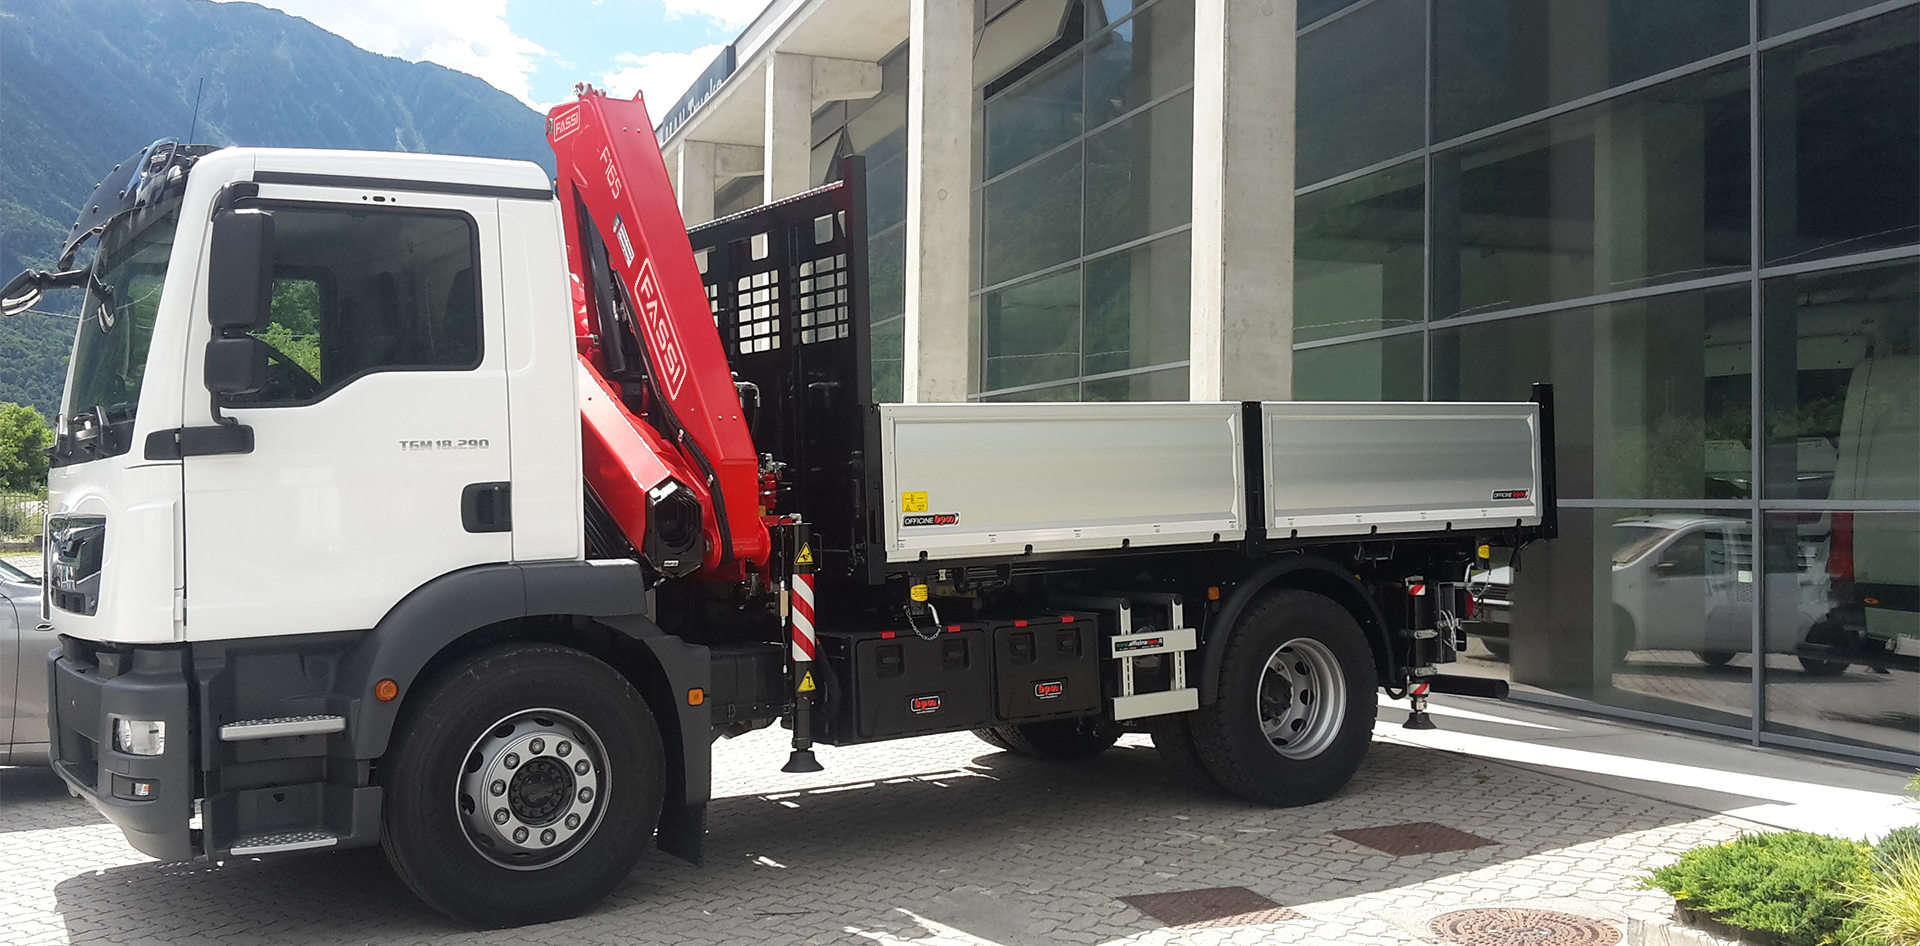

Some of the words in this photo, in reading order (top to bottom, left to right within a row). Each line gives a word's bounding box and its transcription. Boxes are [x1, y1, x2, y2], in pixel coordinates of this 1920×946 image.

[555, 112, 579, 136] FASSI
[600, 145, 622, 200] F165
[641, 274, 681, 384] FASSI
[399, 440, 433, 452] TGM
[436, 439, 490, 451] 18.290
[904, 516, 934, 525] OFFICINE
